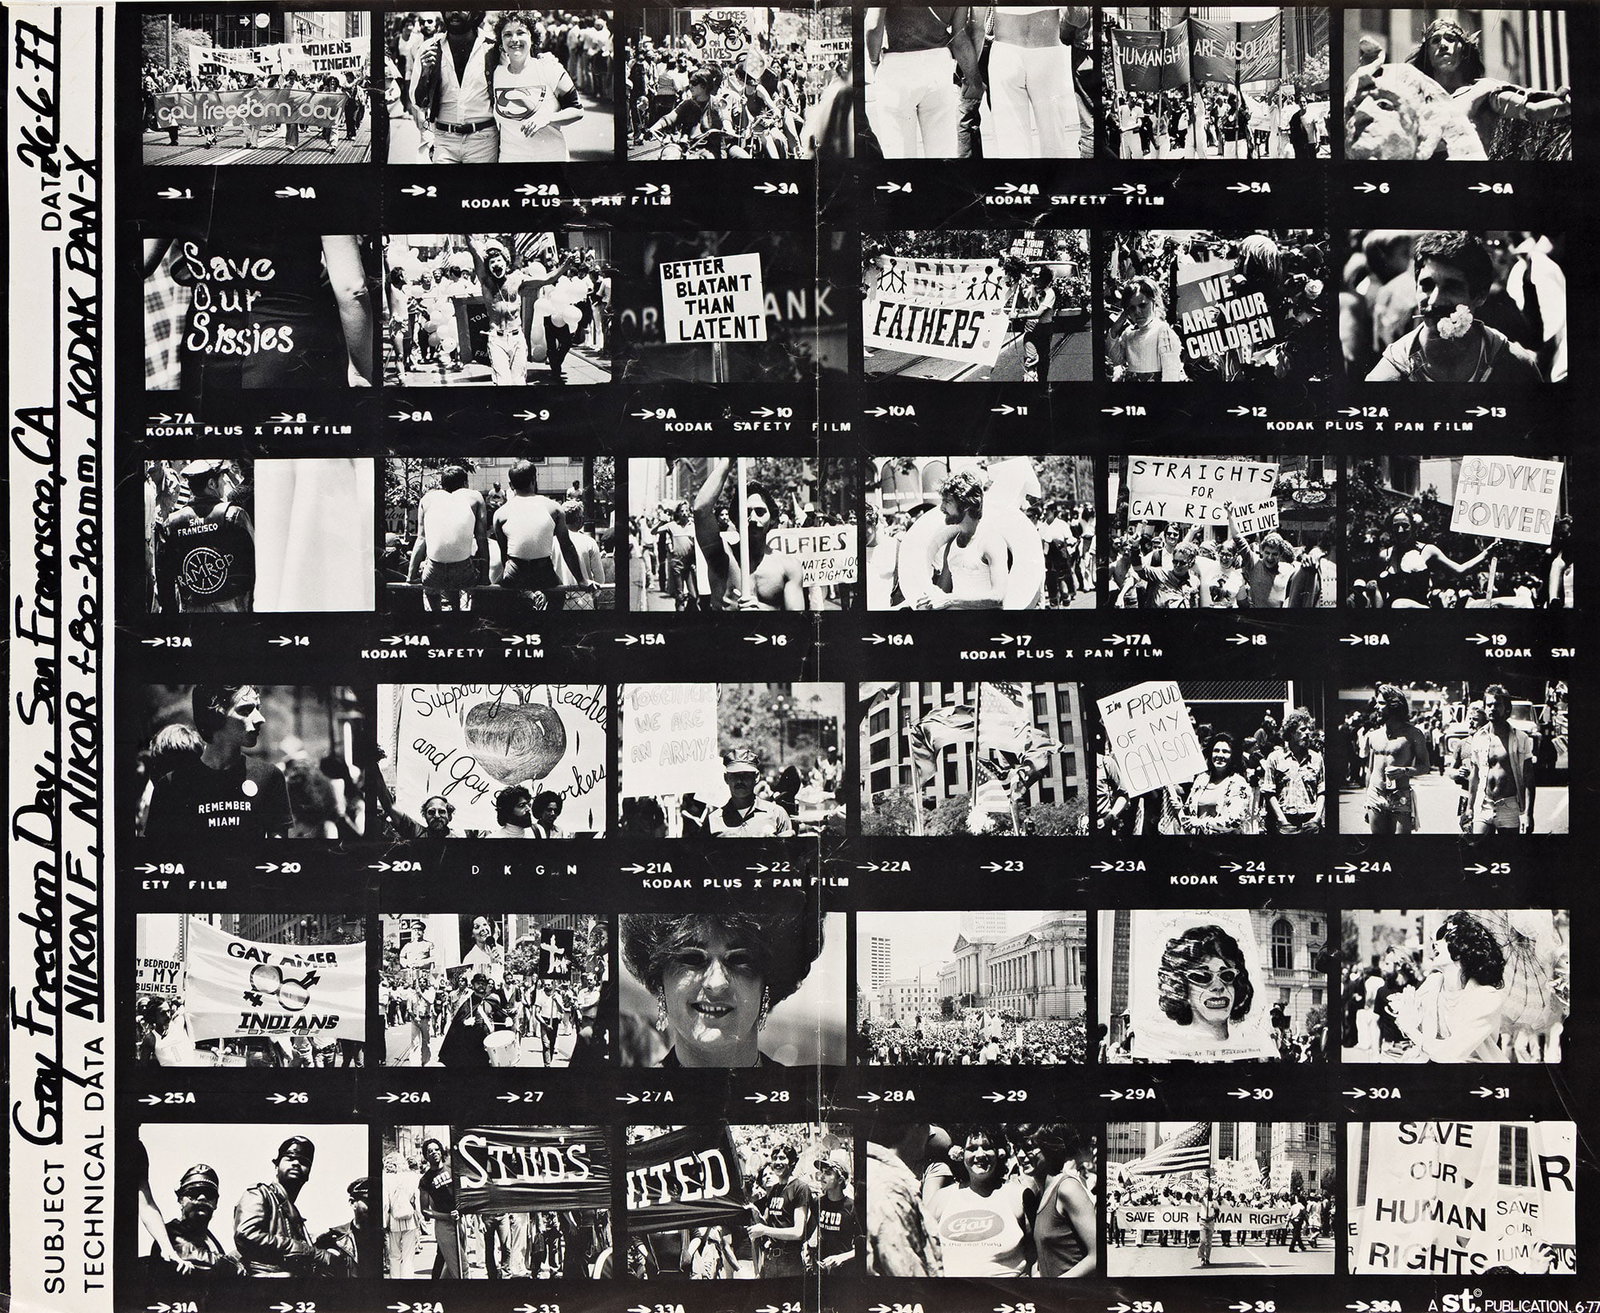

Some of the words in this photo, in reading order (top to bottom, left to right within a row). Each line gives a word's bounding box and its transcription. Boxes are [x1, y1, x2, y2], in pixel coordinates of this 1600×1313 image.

[716, 10, 747, 20] DYKES
[701, 50, 733, 60] BIKES
[1116, 46, 1163, 67] HUMAN
[1193, 38, 1217, 58] ARE
[158, 104, 198, 124] gay
[300, 101, 342, 125] day
[300, 187, 316, 199] 1A
[427, 186, 438, 198] 2
[901, 182, 912, 194] 4
[1250, 182, 1271, 193] 5A
[1492, 183, 1514, 194] 6A
[461, 199, 511, 208] KODAK
[521, 198, 561, 207] PLUS
[632, 196, 671, 206] FILM
[64, 145, 97, 277] PAN-X
[1023, 230, 1036, 239] WE
[1011, 239, 1025, 248] ARE
[1026, 239, 1045, 249] YOUR
[662, 258, 725, 281] BETTER
[676, 274, 752, 299] BLATANT
[1198, 274, 1234, 303] WE
[685, 299, 735, 316] THAN
[1181, 305, 1218, 335] ARE
[1219, 291, 1269, 324] YOUR
[679, 315, 761, 342] LATENT
[872, 300, 985, 350] FATHERS
[1185, 315, 1276, 360] CHILDREN
[67, 286, 97, 420] KODAK
[173, 413, 195, 424] 7A
[411, 410, 433, 422] 8A
[1126, 406, 1147, 417] 11A
[1490, 406, 1507, 418] 13
[11, 407, 56, 466] CA
[145, 426, 194, 436] KODAK
[204, 425, 243, 435] PLUS
[254, 425, 263, 435] X
[273, 425, 303, 435] PAN
[312, 425, 352, 435] FILM
[1132, 460, 1276, 483] STRAIGHTS
[1487, 462, 1557, 495] DYKE
[1191, 486, 1214, 499] FOR
[1132, 500, 1167, 517] GAY
[1234, 503, 1255, 517] LIVE
[1258, 500, 1275, 511] AND
[1455, 499, 1552, 535] POWER
[177, 522, 219, 537] FRANCISCO
[189, 518, 205, 527] SAN
[1237, 519, 1253, 534] LET
[1257, 513, 1278, 530] LIVE
[165, 636, 192, 647] 13A
[771, 635, 787, 646] 16
[960, 650, 1007, 660] KODAK
[1016, 649, 1054, 659] PLUS
[1065, 649, 1074, 659] X
[1084, 648, 1114, 658] PAN
[1123, 648, 1163, 658] FILM
[17, 656, 57, 726] San
[411, 684, 483, 718] Support
[1127, 685, 1181, 719] PROUD
[635, 712, 661, 733] WE
[671, 710, 704, 732] ARE
[1116, 729, 1137, 749] OF
[1149, 710, 1179, 736] MY
[67, 690, 97, 826] NIKOR
[631, 741, 652, 763] AN
[659, 737, 717, 766] ARMY!
[412, 737, 458, 772] and
[441, 755, 490, 805] Gay
[560, 763, 607, 801] orkers
[198, 800, 252, 814] REMEMBER
[208, 816, 240, 827] MIAMI
[280, 862, 301, 874] 20
[882, 861, 911, 872] 22A
[1490, 862, 1511, 874] 25
[1170, 875, 1219, 885] KODAK
[1238, 874, 1296, 885] SAFETY
[1316, 875, 1356, 885] FILM
[11, 861, 57, 1036] Freedom
[64, 894, 97, 1020] NIKON
[227, 942, 271, 964] GAY
[143, 958, 181, 970] BEDROOM
[153, 968, 178, 984] MY
[136, 982, 178, 993] BUSINESS
[238, 1011, 340, 1030] INDIANS
[84, 1037, 104, 1111] DATA
[12, 1052, 88, 1146] Gay
[164, 1091, 196, 1104] 25A
[770, 1090, 790, 1102] 28
[1125, 1087, 1156, 1100] 29A
[1494, 1087, 1510, 1099] 31
[1398, 1121, 1474, 1148] SAVE
[1410, 1160, 1458, 1184] OUR
[84, 1125, 104, 1294] TECHNICAL
[819, 1210, 842, 1226] STUD
[1125, 1211, 1156, 1223] SAVE
[1163, 1211, 1189, 1223] OUR
[1197, 1211, 1243, 1224] HMAN
[1375, 1196, 1487, 1232] HUMAN
[1496, 1200, 1539, 1219] SAVE
[44, 1159, 65, 1295] SUBJECT
[948, 1215, 996, 1238] Gay
[1505, 1223, 1533, 1237] OUR
[1368, 1241, 1488, 1275] RIGHTS
[1254, 1301, 1276, 1312] 36
[1428, 1300, 1439, 1312] A
